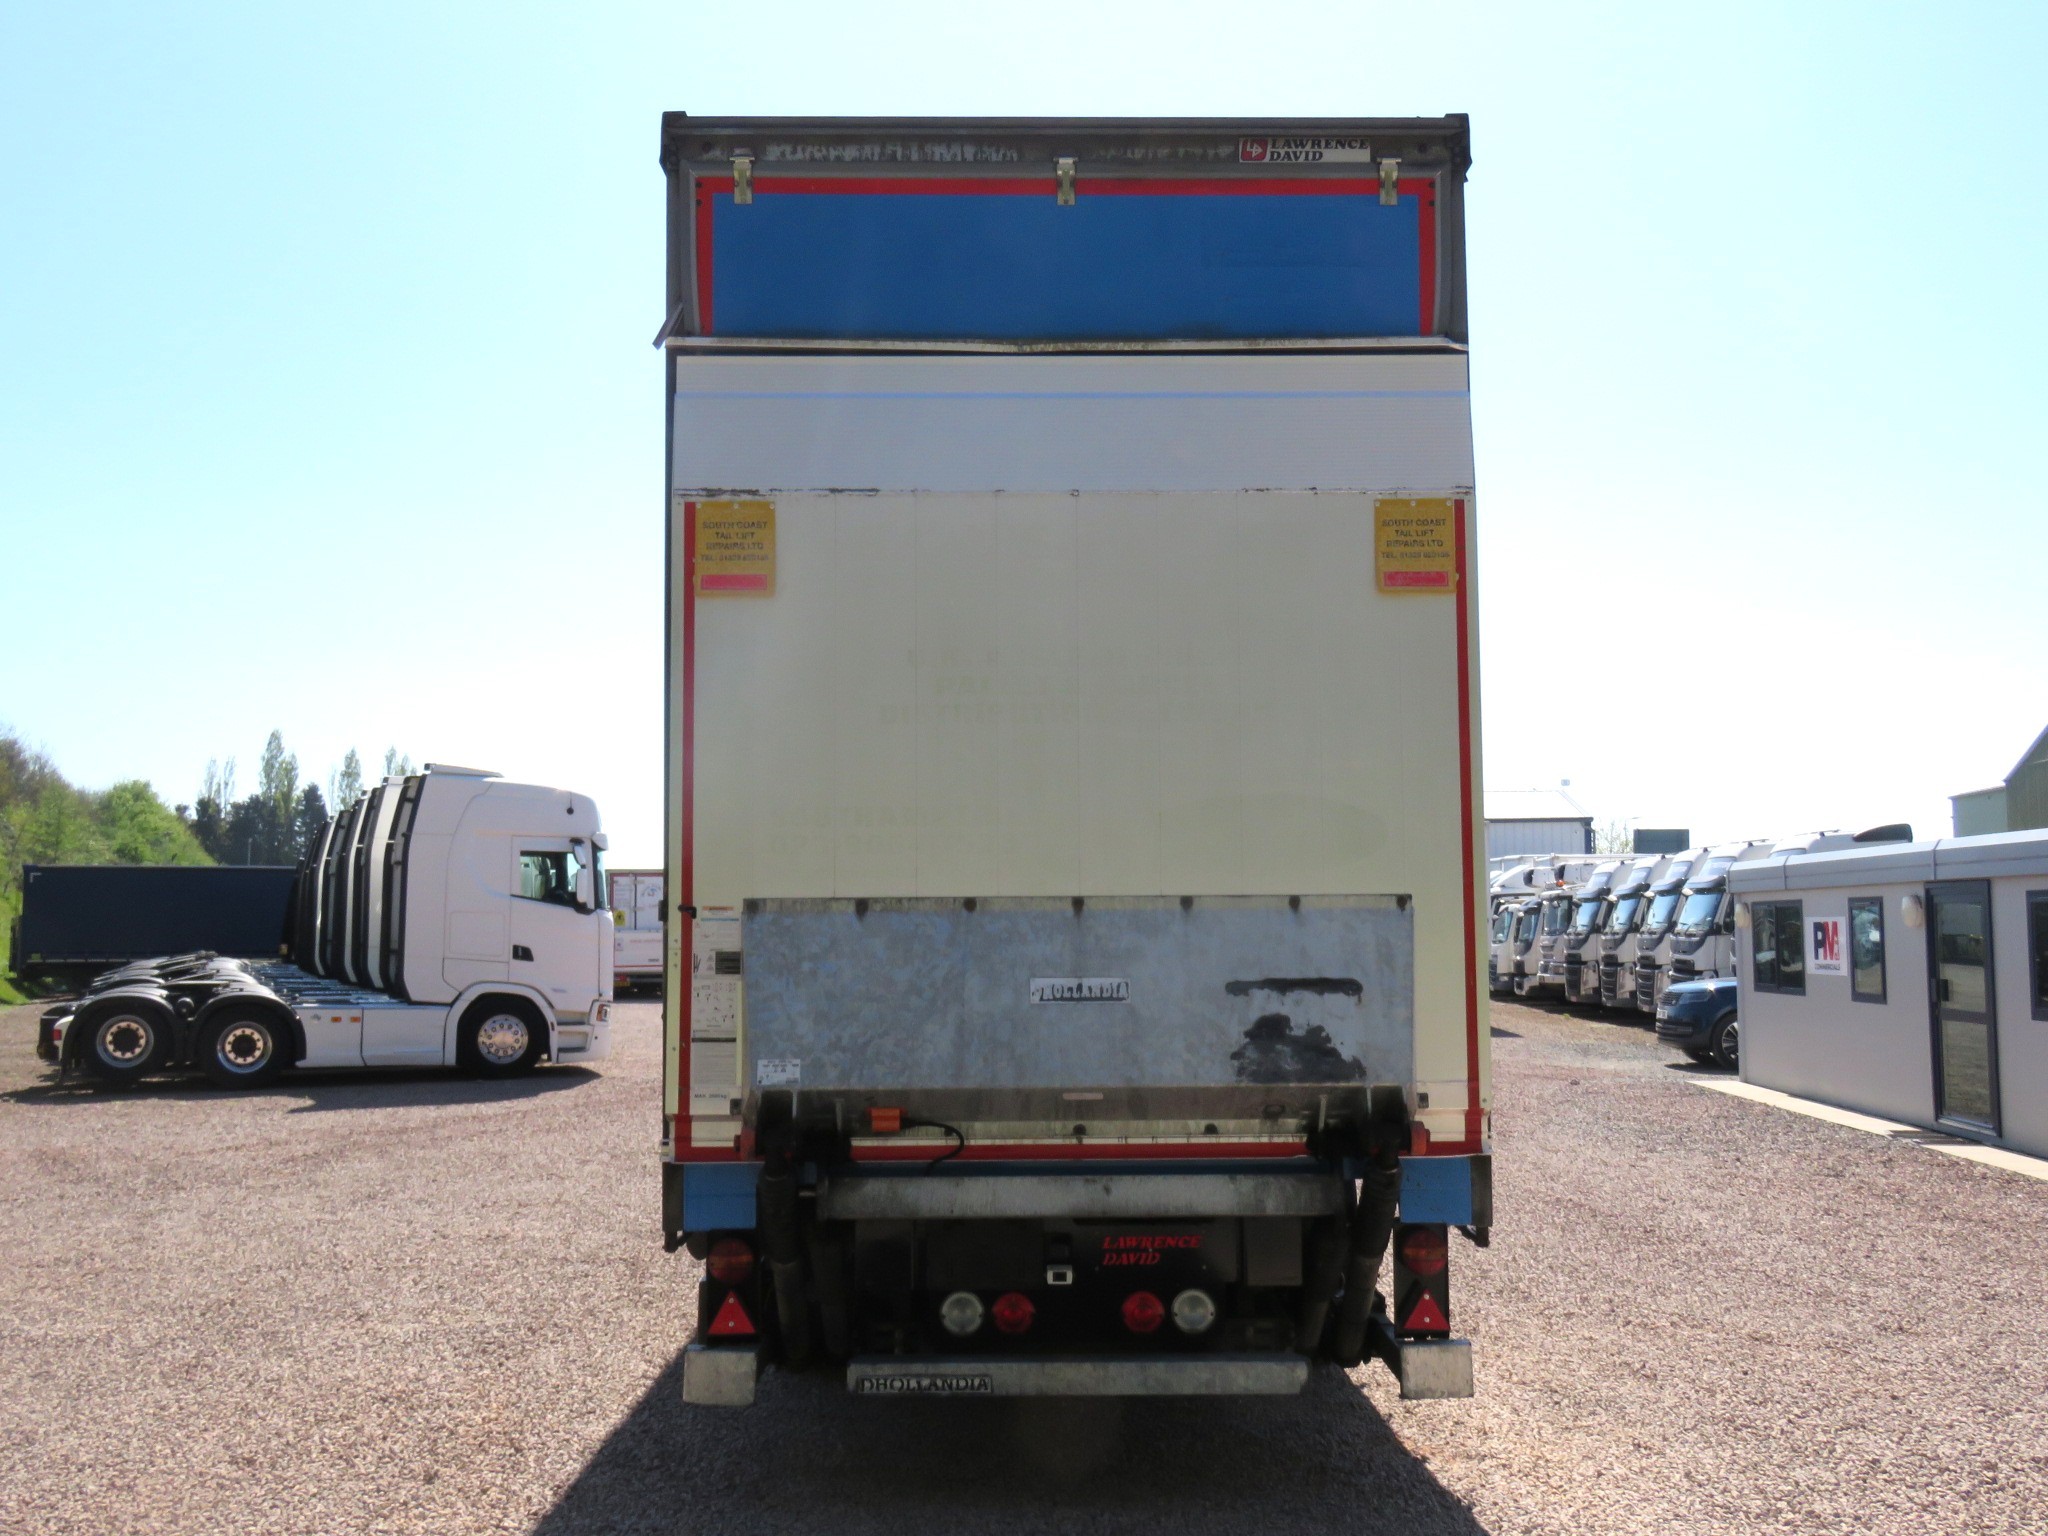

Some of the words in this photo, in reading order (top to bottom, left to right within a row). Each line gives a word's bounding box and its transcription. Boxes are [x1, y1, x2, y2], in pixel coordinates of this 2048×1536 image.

[1269, 138, 1370, 150] LAWRENCE
[1269, 150, 1323, 162] DAVID
[702, 521, 734, 529] SOUTH
[736, 520, 768, 529] COAST
[1382, 519, 1414, 527] SOUTH
[1416, 518, 1447, 527] COAST
[715, 531, 732, 540] TAIL
[736, 531, 756, 540] LIFT
[1394, 529, 1413, 538] TAIL
[1416, 529, 1435, 538] LIFT
[705, 541, 746, 551] REPAIRS
[747, 541, 764, 550] LTD
[1386, 539, 1425, 548] REPAIRS
[1427, 539, 1444, 548] LTD
[1103, 1235, 1204, 1249] LAWRENCE
[1103, 1252, 1161, 1265] DAVID
[861, 1377, 989, 1392] DHOLLANDIA
